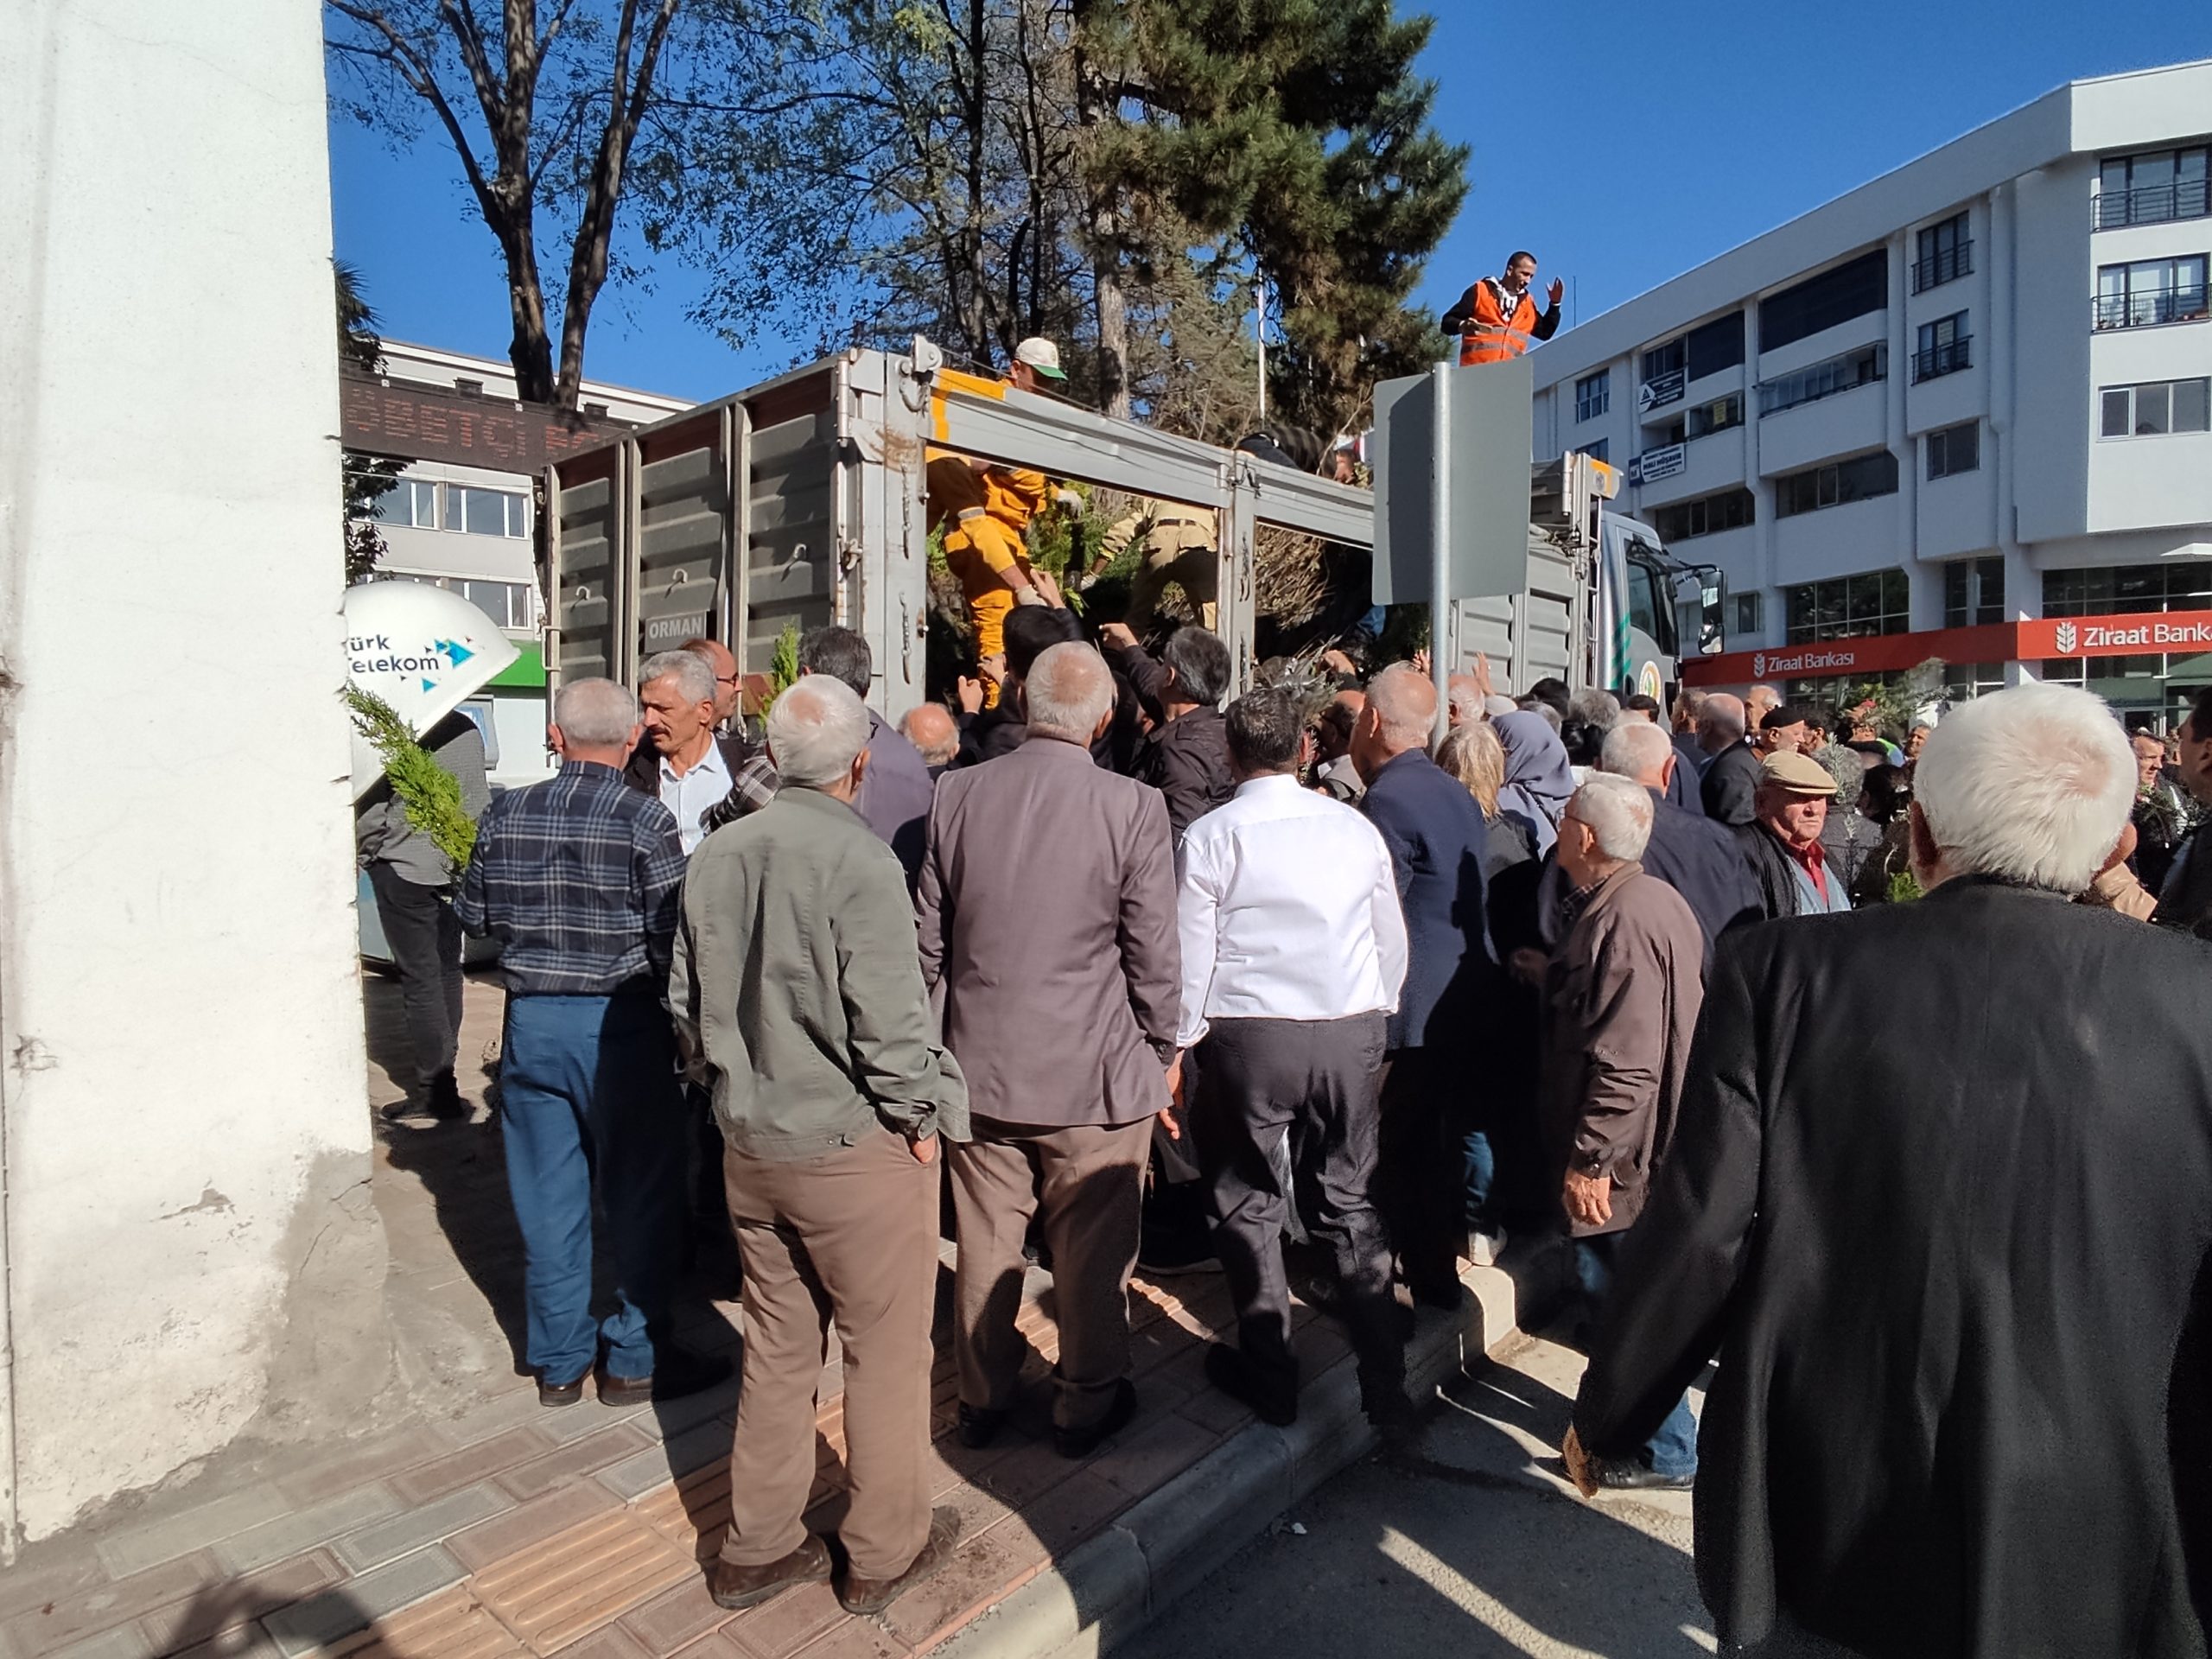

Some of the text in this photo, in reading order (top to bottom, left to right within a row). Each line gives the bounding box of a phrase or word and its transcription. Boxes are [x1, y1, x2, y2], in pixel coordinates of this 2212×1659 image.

[346, 388, 526, 458] ÖBETÇİ
[649, 616, 702, 639] ORMAN
[2083, 621, 2212, 647] Ziraat Bank
[349, 633, 391, 652] ürk
[348, 654, 440, 674] elekom
[1768, 651, 1854, 672] Ziraat Bankası
